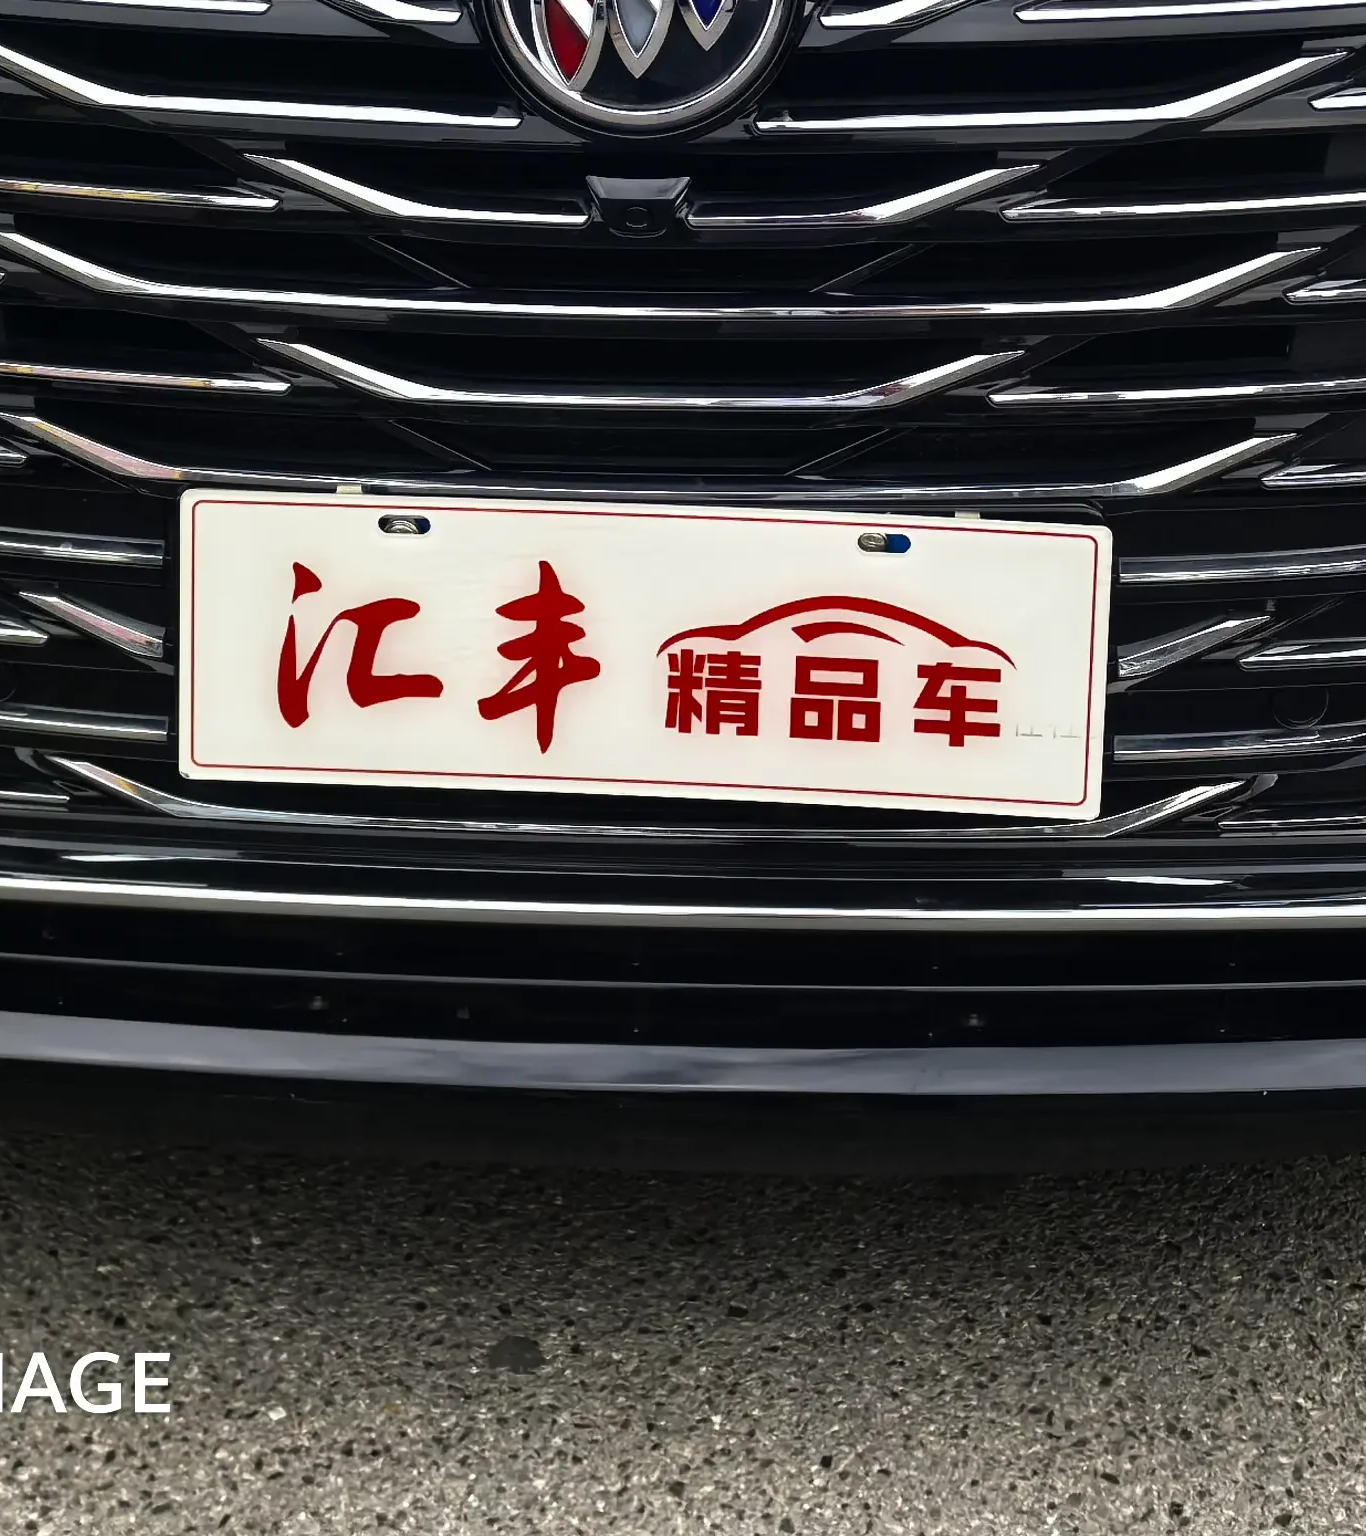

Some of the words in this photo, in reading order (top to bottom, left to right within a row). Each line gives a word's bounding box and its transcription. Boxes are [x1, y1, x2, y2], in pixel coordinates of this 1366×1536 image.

[277, 560, 602, 755] 汇丰
[663, 648, 1003, 748] 精品车
